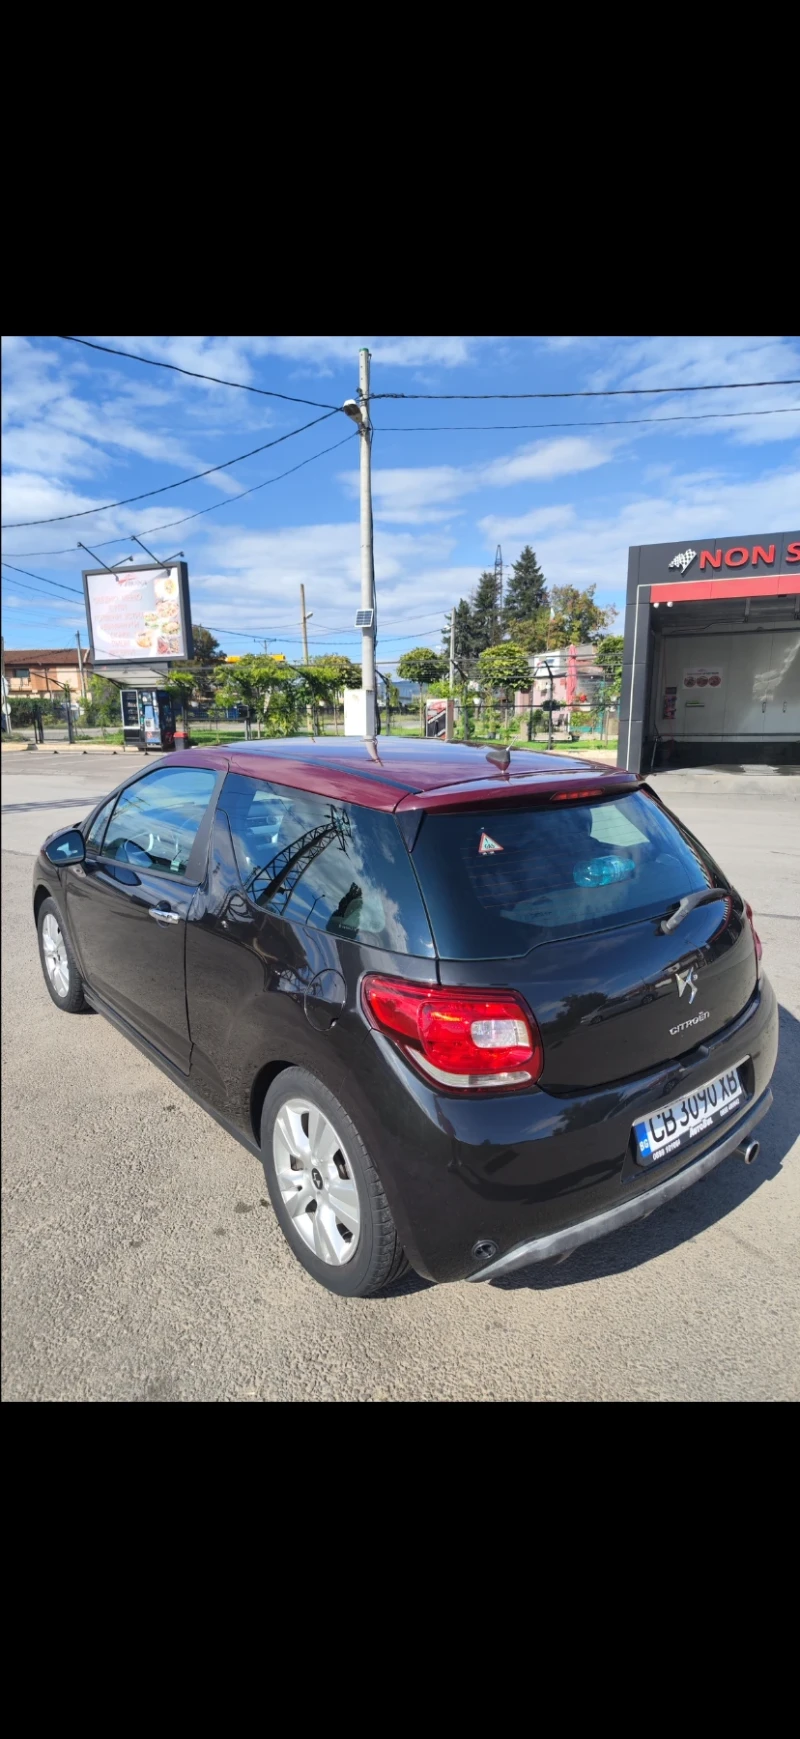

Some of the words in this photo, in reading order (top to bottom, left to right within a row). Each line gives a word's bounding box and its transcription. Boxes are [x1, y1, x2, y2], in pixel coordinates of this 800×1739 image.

[699, 544, 775, 569] NON
[648, 1108, 677, 1143] CB
[680, 1083, 717, 1127] 3090
[639, 1139, 649, 1152] BG
